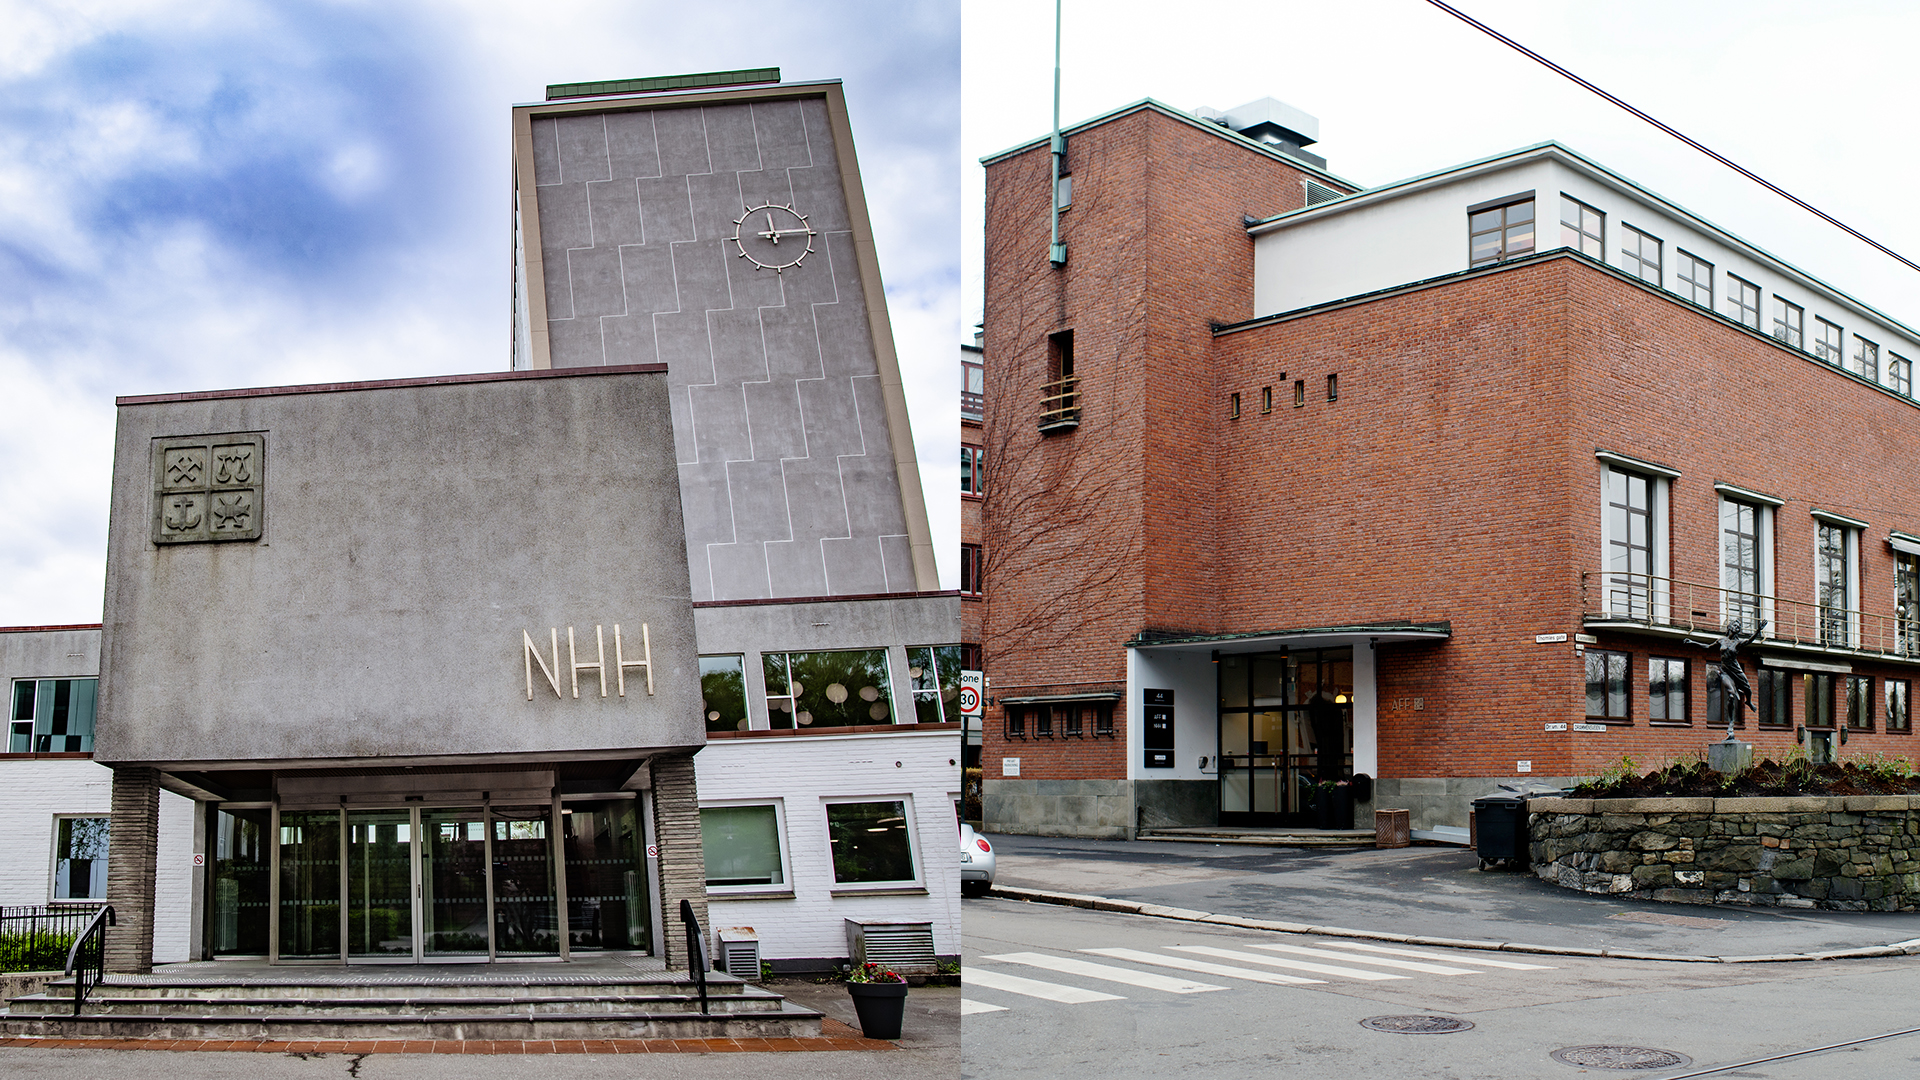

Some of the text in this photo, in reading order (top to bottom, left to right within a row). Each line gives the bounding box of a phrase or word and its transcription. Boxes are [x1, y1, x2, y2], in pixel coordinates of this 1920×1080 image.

[523, 623, 654, 701] NHH
[961, 674, 979, 683] one
[961, 694, 975, 705] 30
[1392, 698, 1410, 711] AFF
